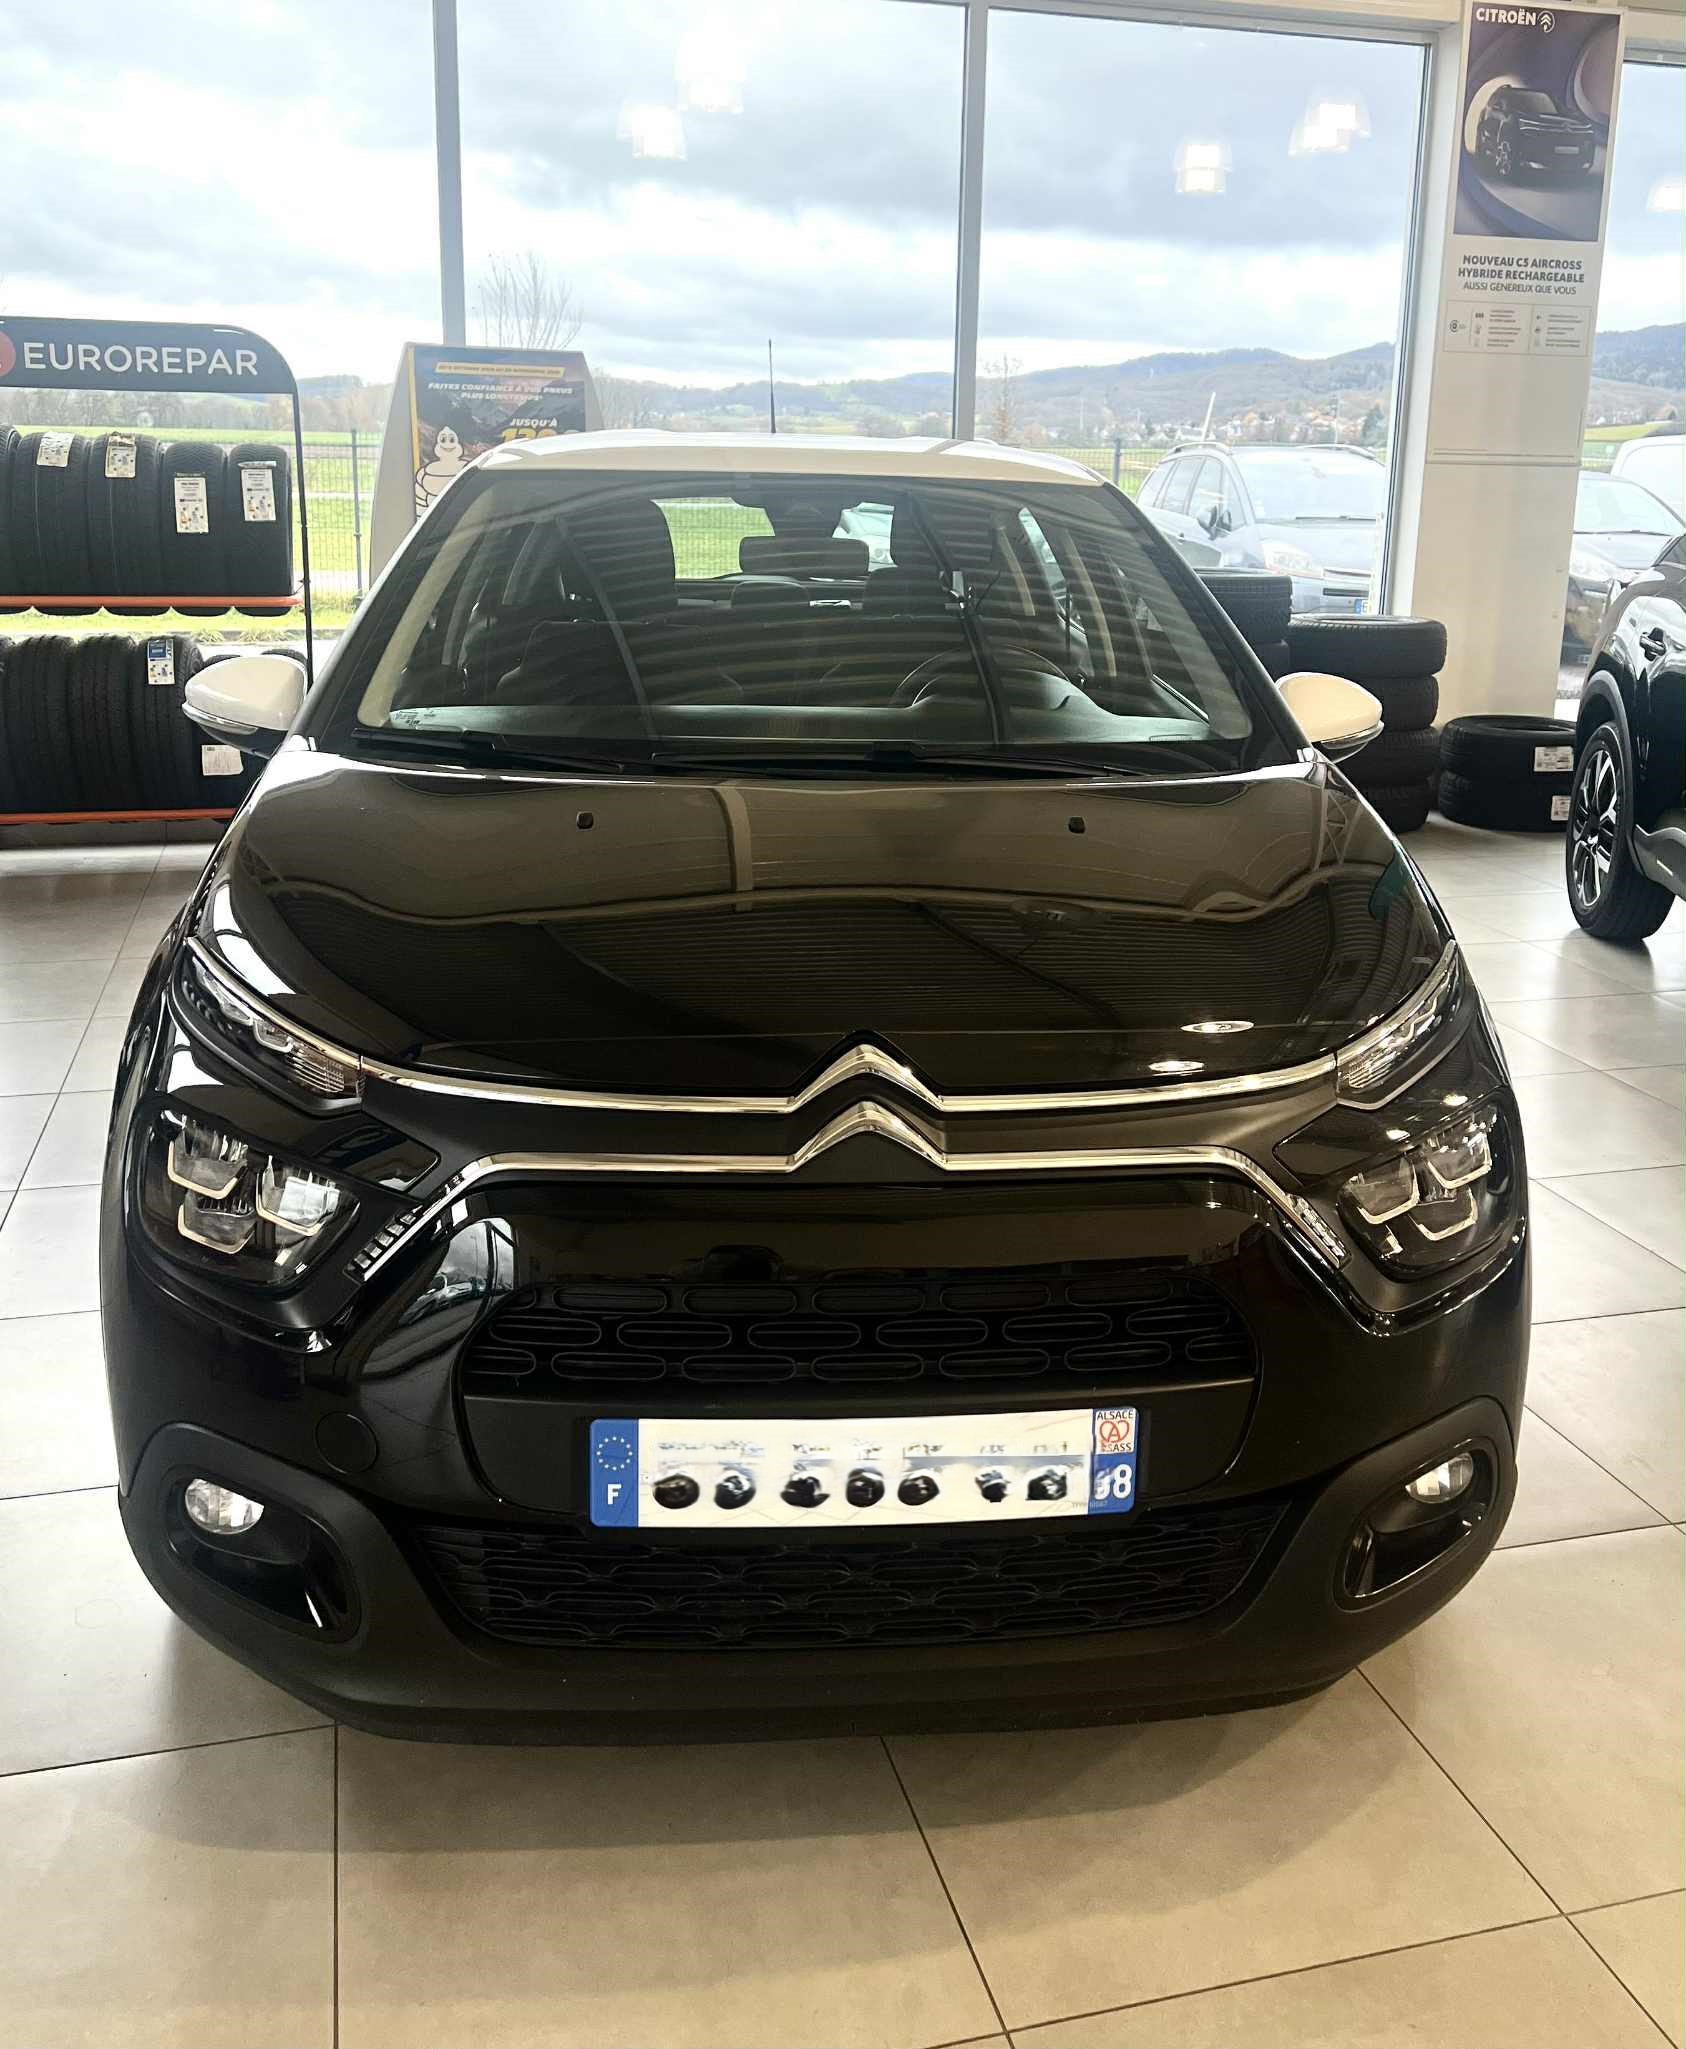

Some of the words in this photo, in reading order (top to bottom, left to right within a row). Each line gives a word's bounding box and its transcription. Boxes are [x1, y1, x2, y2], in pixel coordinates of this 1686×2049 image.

[1475, 7, 1537, 26] CITROËN
[1462, 254, 1514, 268] NOUVEAU
[1516, 257, 1529, 268] C5
[1530, 258, 1583, 270] AIRCROSS
[1458, 267, 1504, 280] HYBRIDE
[1505, 269, 1585, 283] RECHARGEABLE
[1463, 281, 1488, 291] AUSSI
[1535, 284, 1553, 294] QUE
[1554, 285, 1577, 295] VOUS
[23, 341, 259, 377] EUROREPAR
[1097, 1411, 1134, 1421] ALSACE
[607, 1483, 622, 1505] F
